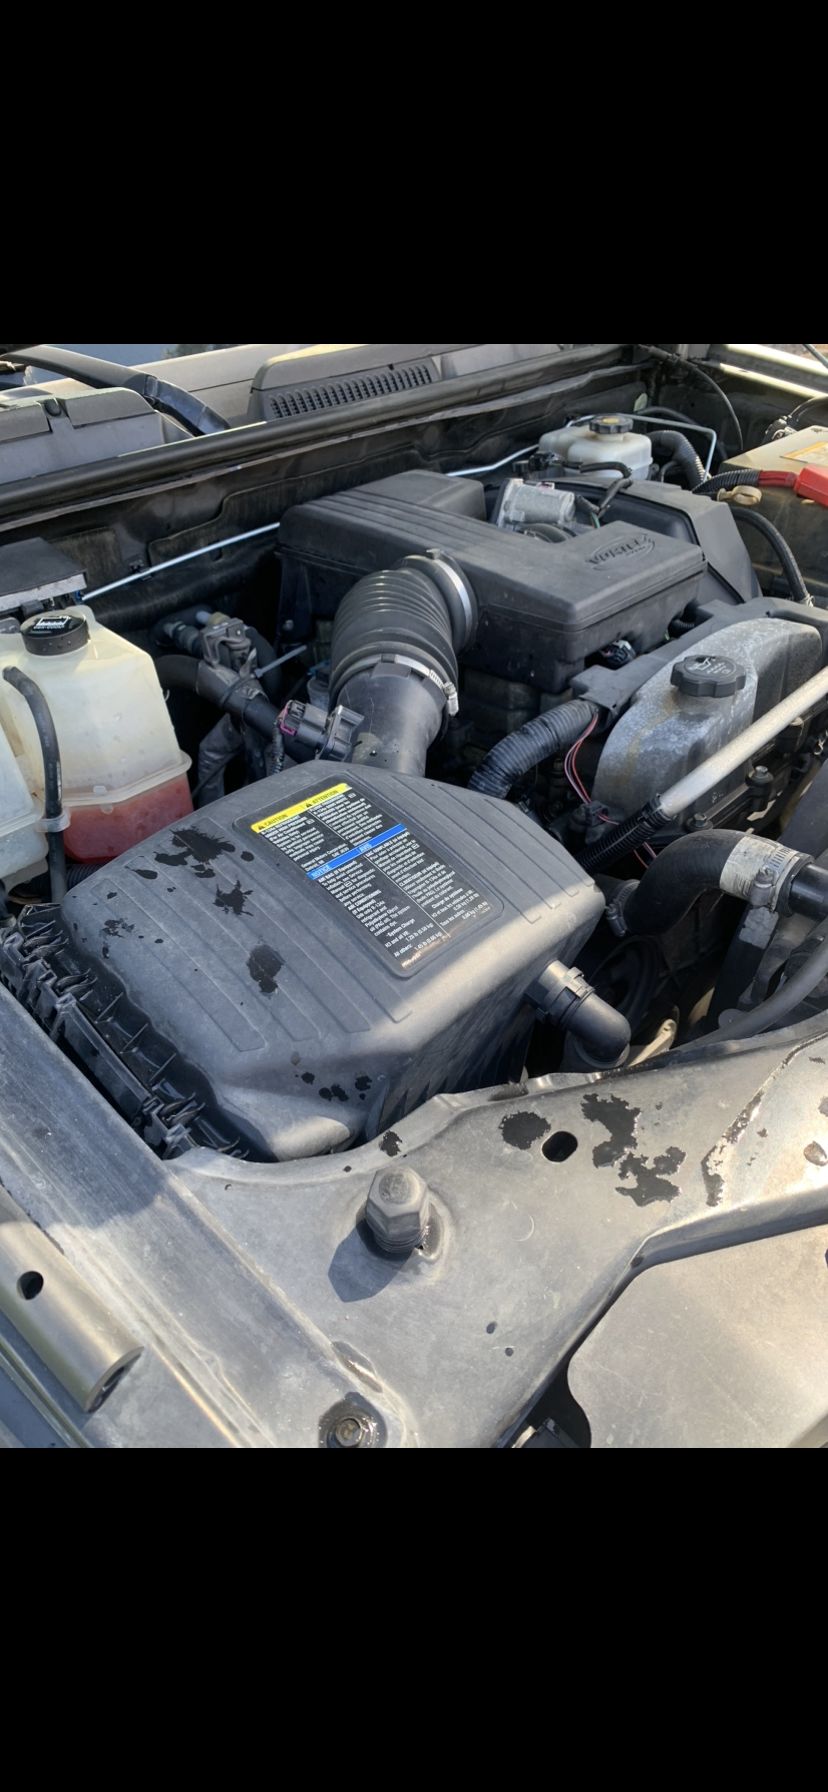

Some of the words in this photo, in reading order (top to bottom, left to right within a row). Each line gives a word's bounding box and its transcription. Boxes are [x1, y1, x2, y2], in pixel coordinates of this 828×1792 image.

[312, 790, 339, 804] ATTENTION
[263, 814, 288, 827] CAUTION
[358, 843, 372, 852] AVIS
[310, 865, 332, 877] NOTICE
